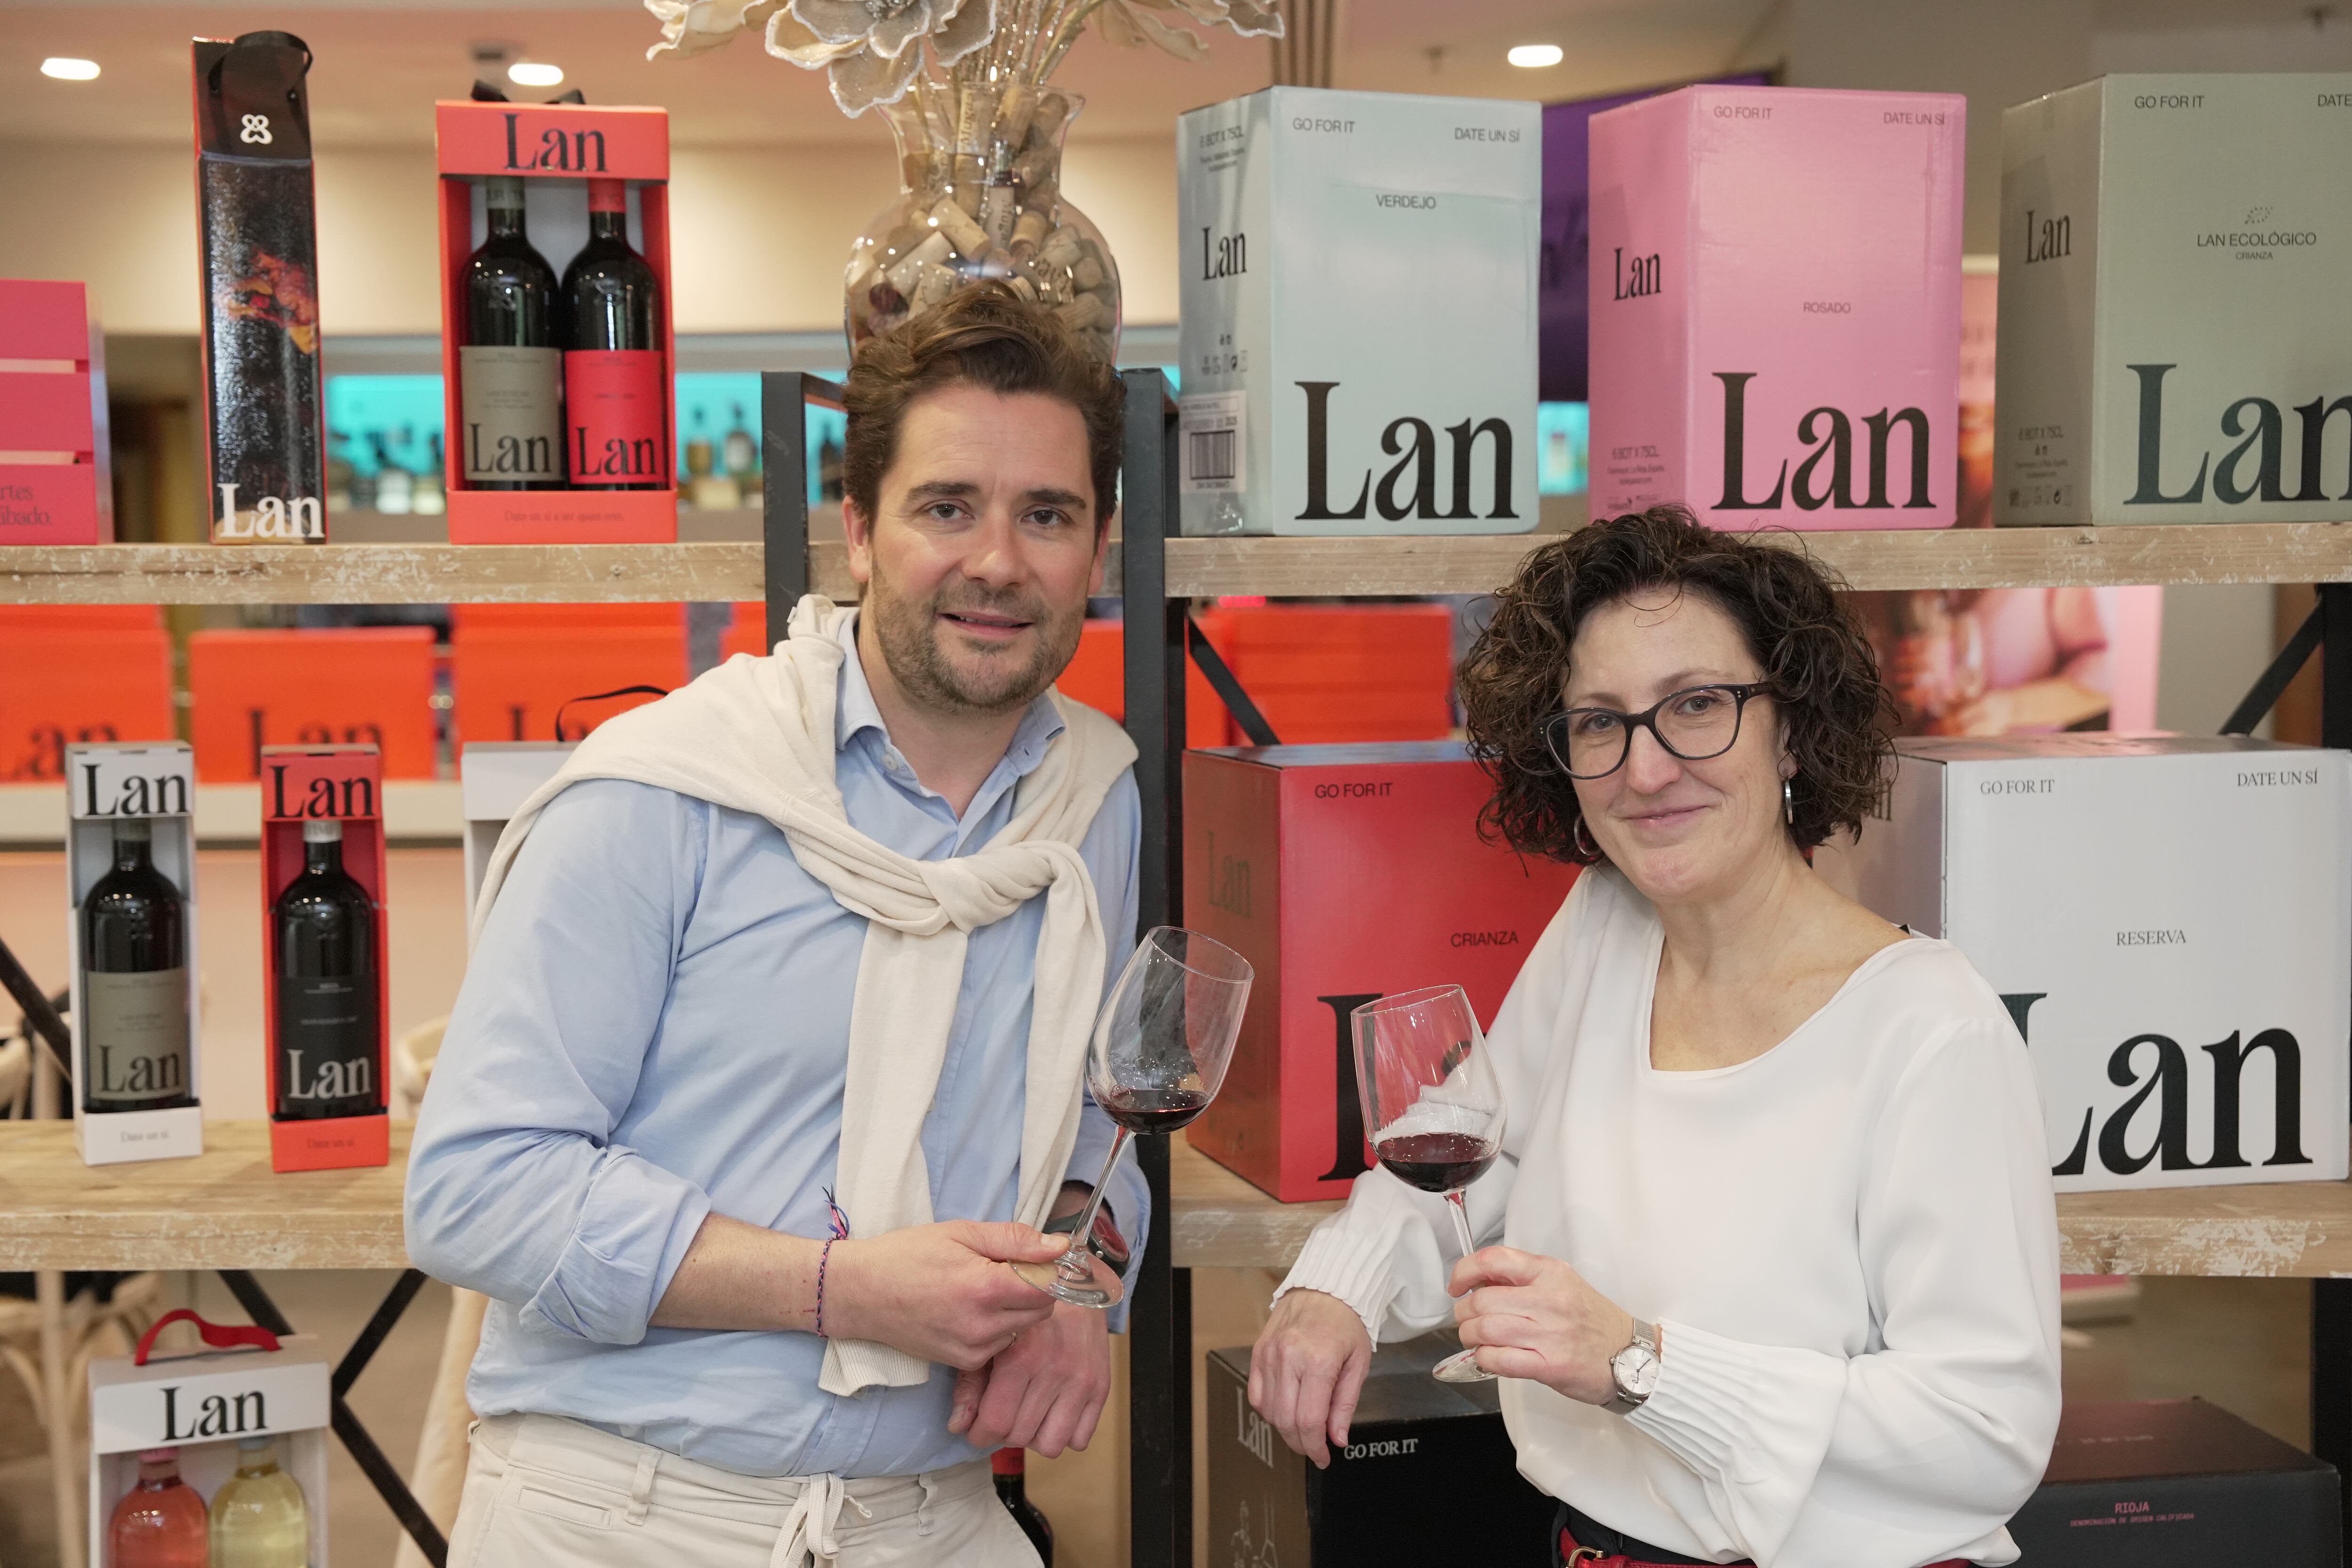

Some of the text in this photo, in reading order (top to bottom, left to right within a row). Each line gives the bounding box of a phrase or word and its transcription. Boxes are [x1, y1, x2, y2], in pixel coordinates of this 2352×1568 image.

[1293, 118, 1355, 133] GO FOR IT
[1714, 106, 1772, 119] GO FOR IT
[1884, 112, 1913, 124] DATE
[1915, 114, 1931, 125] UN
[2135, 96, 2204, 109] GO FOR IT
[505, 114, 607, 172] Lan
[1454, 127, 1485, 141] DATE
[1488, 130, 1506, 142] UN
[1376, 195, 1436, 209] VERDEJO
[1202, 227, 1246, 281] Lan
[2025, 210, 2070, 264] Lan
[2198, 230, 2316, 247] LAN ECOLÓGICO
[1613, 247, 1661, 301] Lan
[1804, 302, 1851, 314] ROSADO
[470, 423, 550, 472] Lan
[577, 426, 656, 476] Lan
[1295, 382, 1519, 521] Lan
[1710, 373, 1937, 511] Lan
[2123, 365, 2352, 504] Lan
[217, 482, 326, 539] Lan
[81, 763, 188, 816] Lan
[270, 765, 374, 819] Lan
[1315, 782, 1393, 798] GO FOR IT
[1980, 780, 2054, 794] GO FOR IT
[2238, 767, 2317, 786] DATE UN SÍ
[1208, 831, 1253, 918] Lan
[1451, 931, 1518, 947] CRIANZA
[2117, 930, 2186, 945] RESERVA
[98, 1045, 181, 1094] Lan
[288, 1050, 369, 1099] Lan
[163, 1387, 269, 1443] Lan
[1236, 1386, 1274, 1468] Lan
[1344, 1439, 1418, 1460] GO FOR IT
[2115, 1502, 2149, 1513] RIOJA
